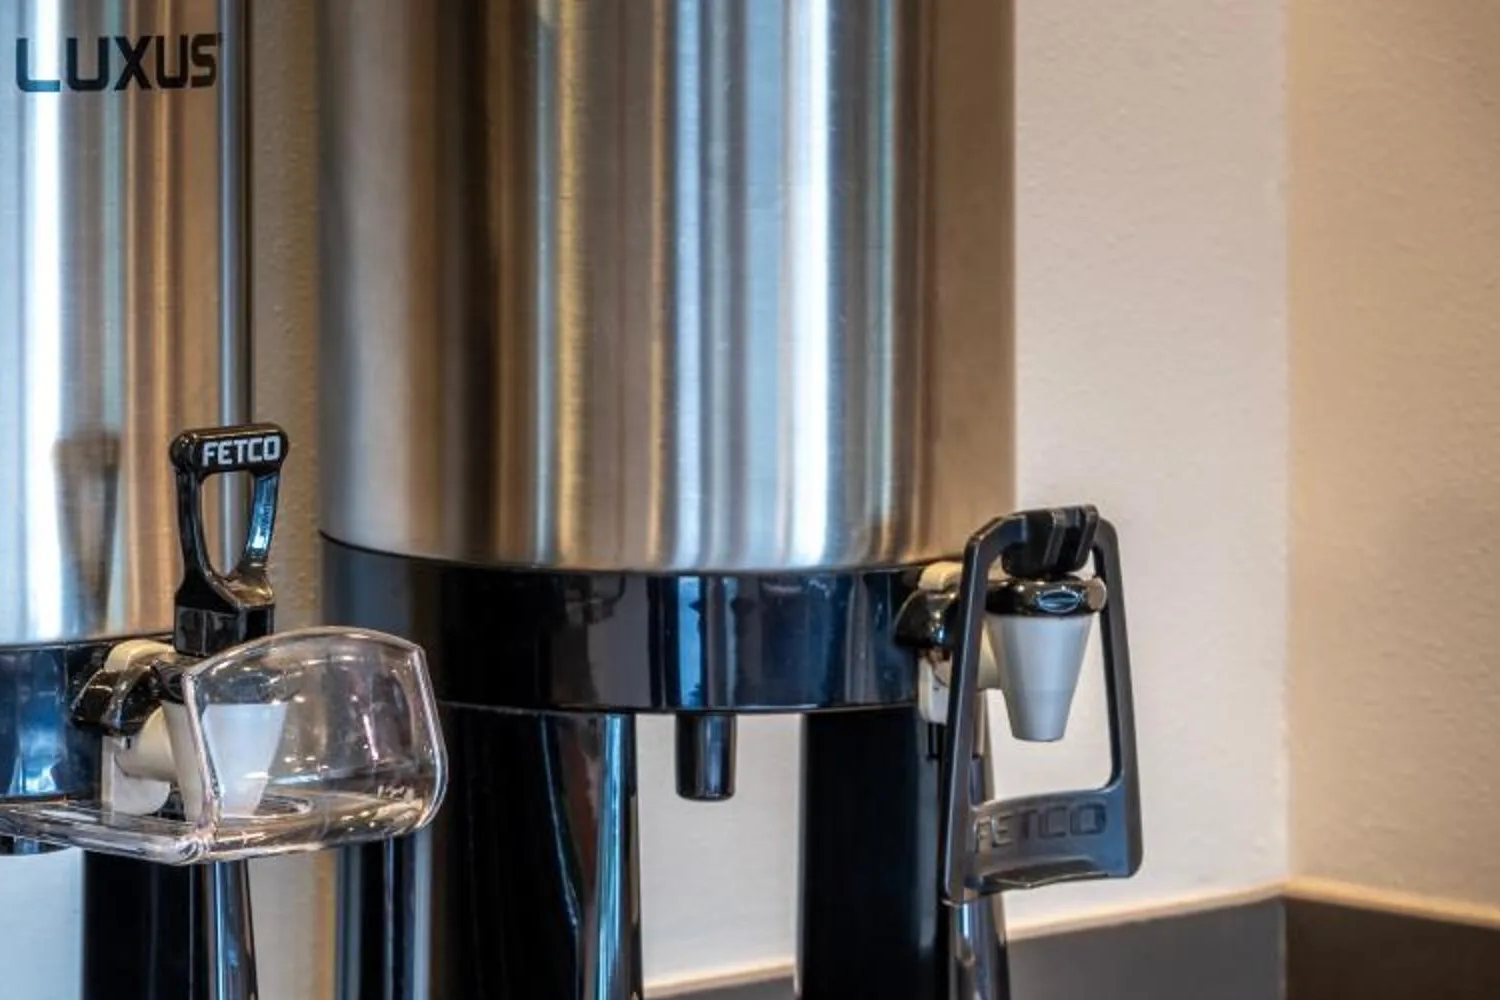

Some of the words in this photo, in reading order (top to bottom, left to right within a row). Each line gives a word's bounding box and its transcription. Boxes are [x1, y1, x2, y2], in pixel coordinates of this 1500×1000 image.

[15, 33, 220, 92] LUXUS
[202, 435, 280, 466] FETCO
[973, 803, 1107, 853] FETCO
